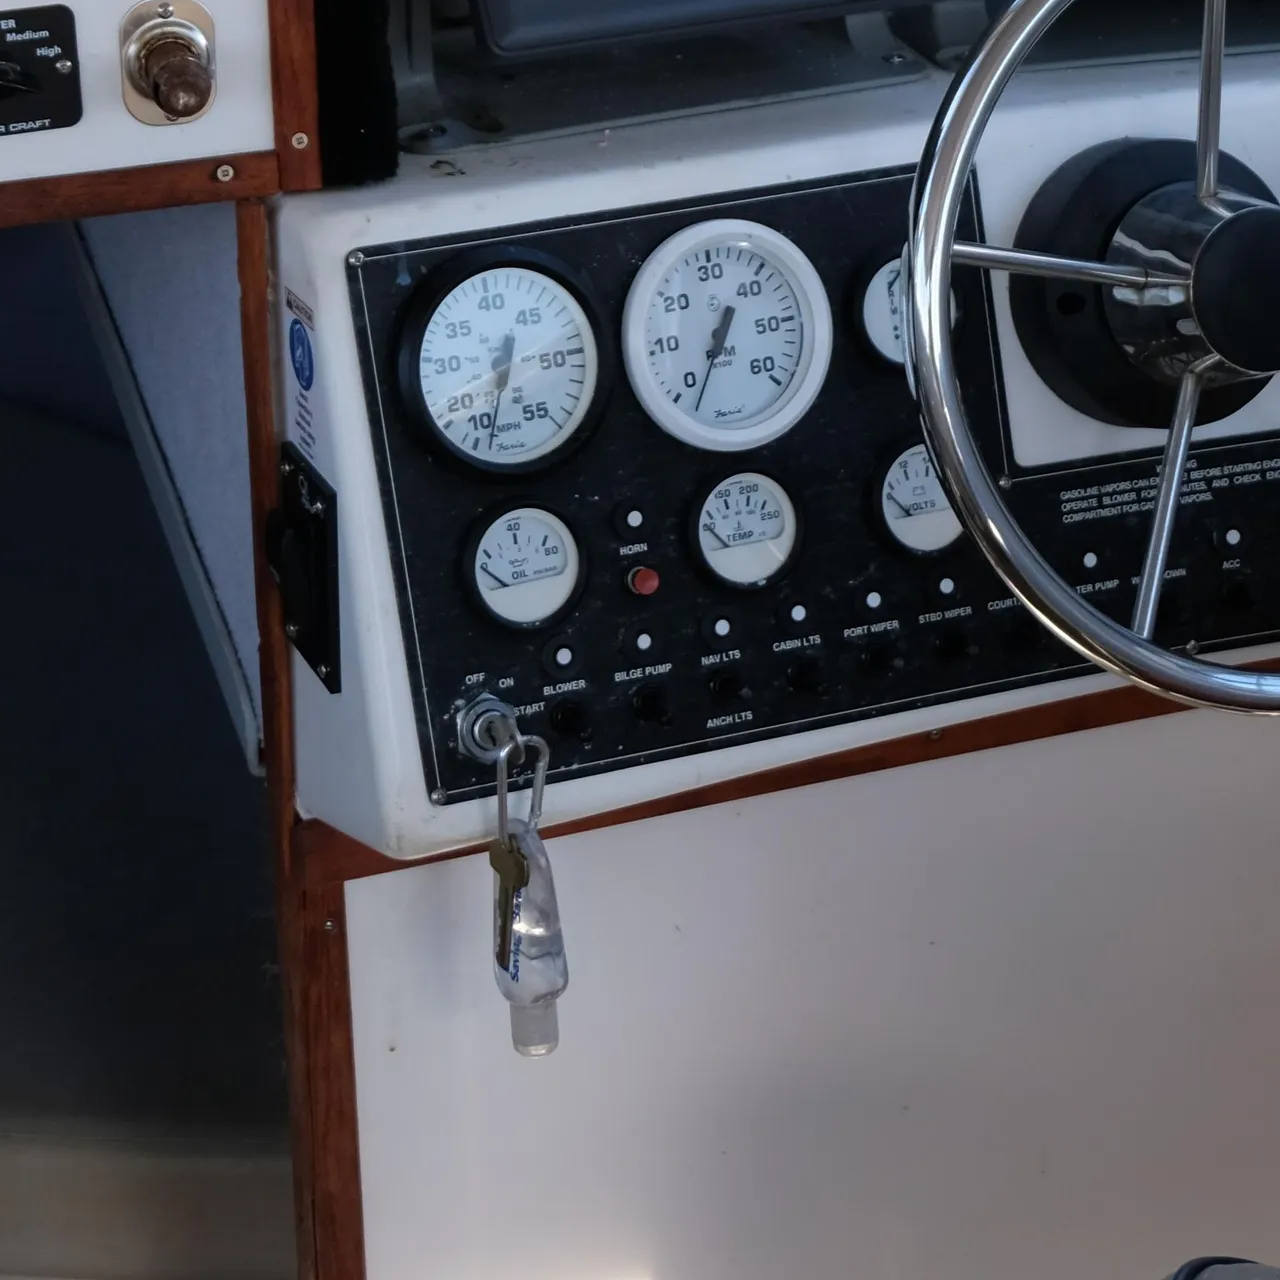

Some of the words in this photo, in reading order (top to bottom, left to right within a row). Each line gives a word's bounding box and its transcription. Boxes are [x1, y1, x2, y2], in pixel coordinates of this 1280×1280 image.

[6, 30, 49, 41] Medium
[36, 45, 62, 58] High
[9, 119, 52, 132] CRAFT
[697, 263, 724, 282] 30
[736, 280, 762, 298] 40
[478, 293, 505, 312] 40
[663, 293, 690, 313] 20
[515, 307, 542, 326] 45
[755, 315, 780, 335] 50
[445, 320, 472, 339] 35
[654, 335, 679, 354] 10
[433, 355, 461, 376] 30
[539, 350, 566, 370] 50
[750, 356, 775, 375] 60
[684, 371, 697, 388] 0
[447, 393, 474, 413] 20
[522, 401, 549, 421] 55
[467, 413, 493, 431] 10
[497, 421, 521, 434] MPH
[1190, 467, 1222, 480] BEFORE
[1223, 461, 1262, 475] STARTING
[738, 483, 759, 495] 200
[1060, 485, 1099, 500] GASOLINE
[1099, 480, 1132, 493] VAPORS
[1132, 478, 1149, 488] CAN
[1211, 478, 1230, 488] AND
[1233, 473, 1262, 484] CHECK
[904, 499, 936, 511] VOLTS
[1061, 497, 1099, 512] OPERATE
[1102, 491, 1137, 505] BLOWER
[760, 510, 780, 521] 250
[1062, 506, 1121, 523] COMPARTMENT
[1123, 503, 1139, 513] FOR
[506, 522, 520, 532] 40
[726, 530, 754, 542] TEMP
[544, 545, 558, 556] 80
[619, 543, 648, 556] HORN
[1222, 558, 1241, 570] ACC
[511, 569, 528, 580] OIL
[1095, 579, 1119, 592] PUMP
[918, 611, 943, 625] STBD
[944, 605, 973, 619] WIPER
[843, 625, 869, 638] PORT
[870, 619, 900, 634] WIPER
[772, 638, 802, 652] CABIN
[803, 634, 822, 646] LTS
[701, 653, 721, 666] NAV
[722, 649, 741, 662] LTS
[465, 672, 486, 685] OFF
[614, 668, 643, 682] BILGE
[645, 662, 672, 676] PUMP
[499, 677, 515, 688] ON
[543, 679, 586, 696] BLOWER
[514, 701, 547, 718] START
[705, 715, 734, 729] ANCH
[735, 710, 753, 724] LTS
